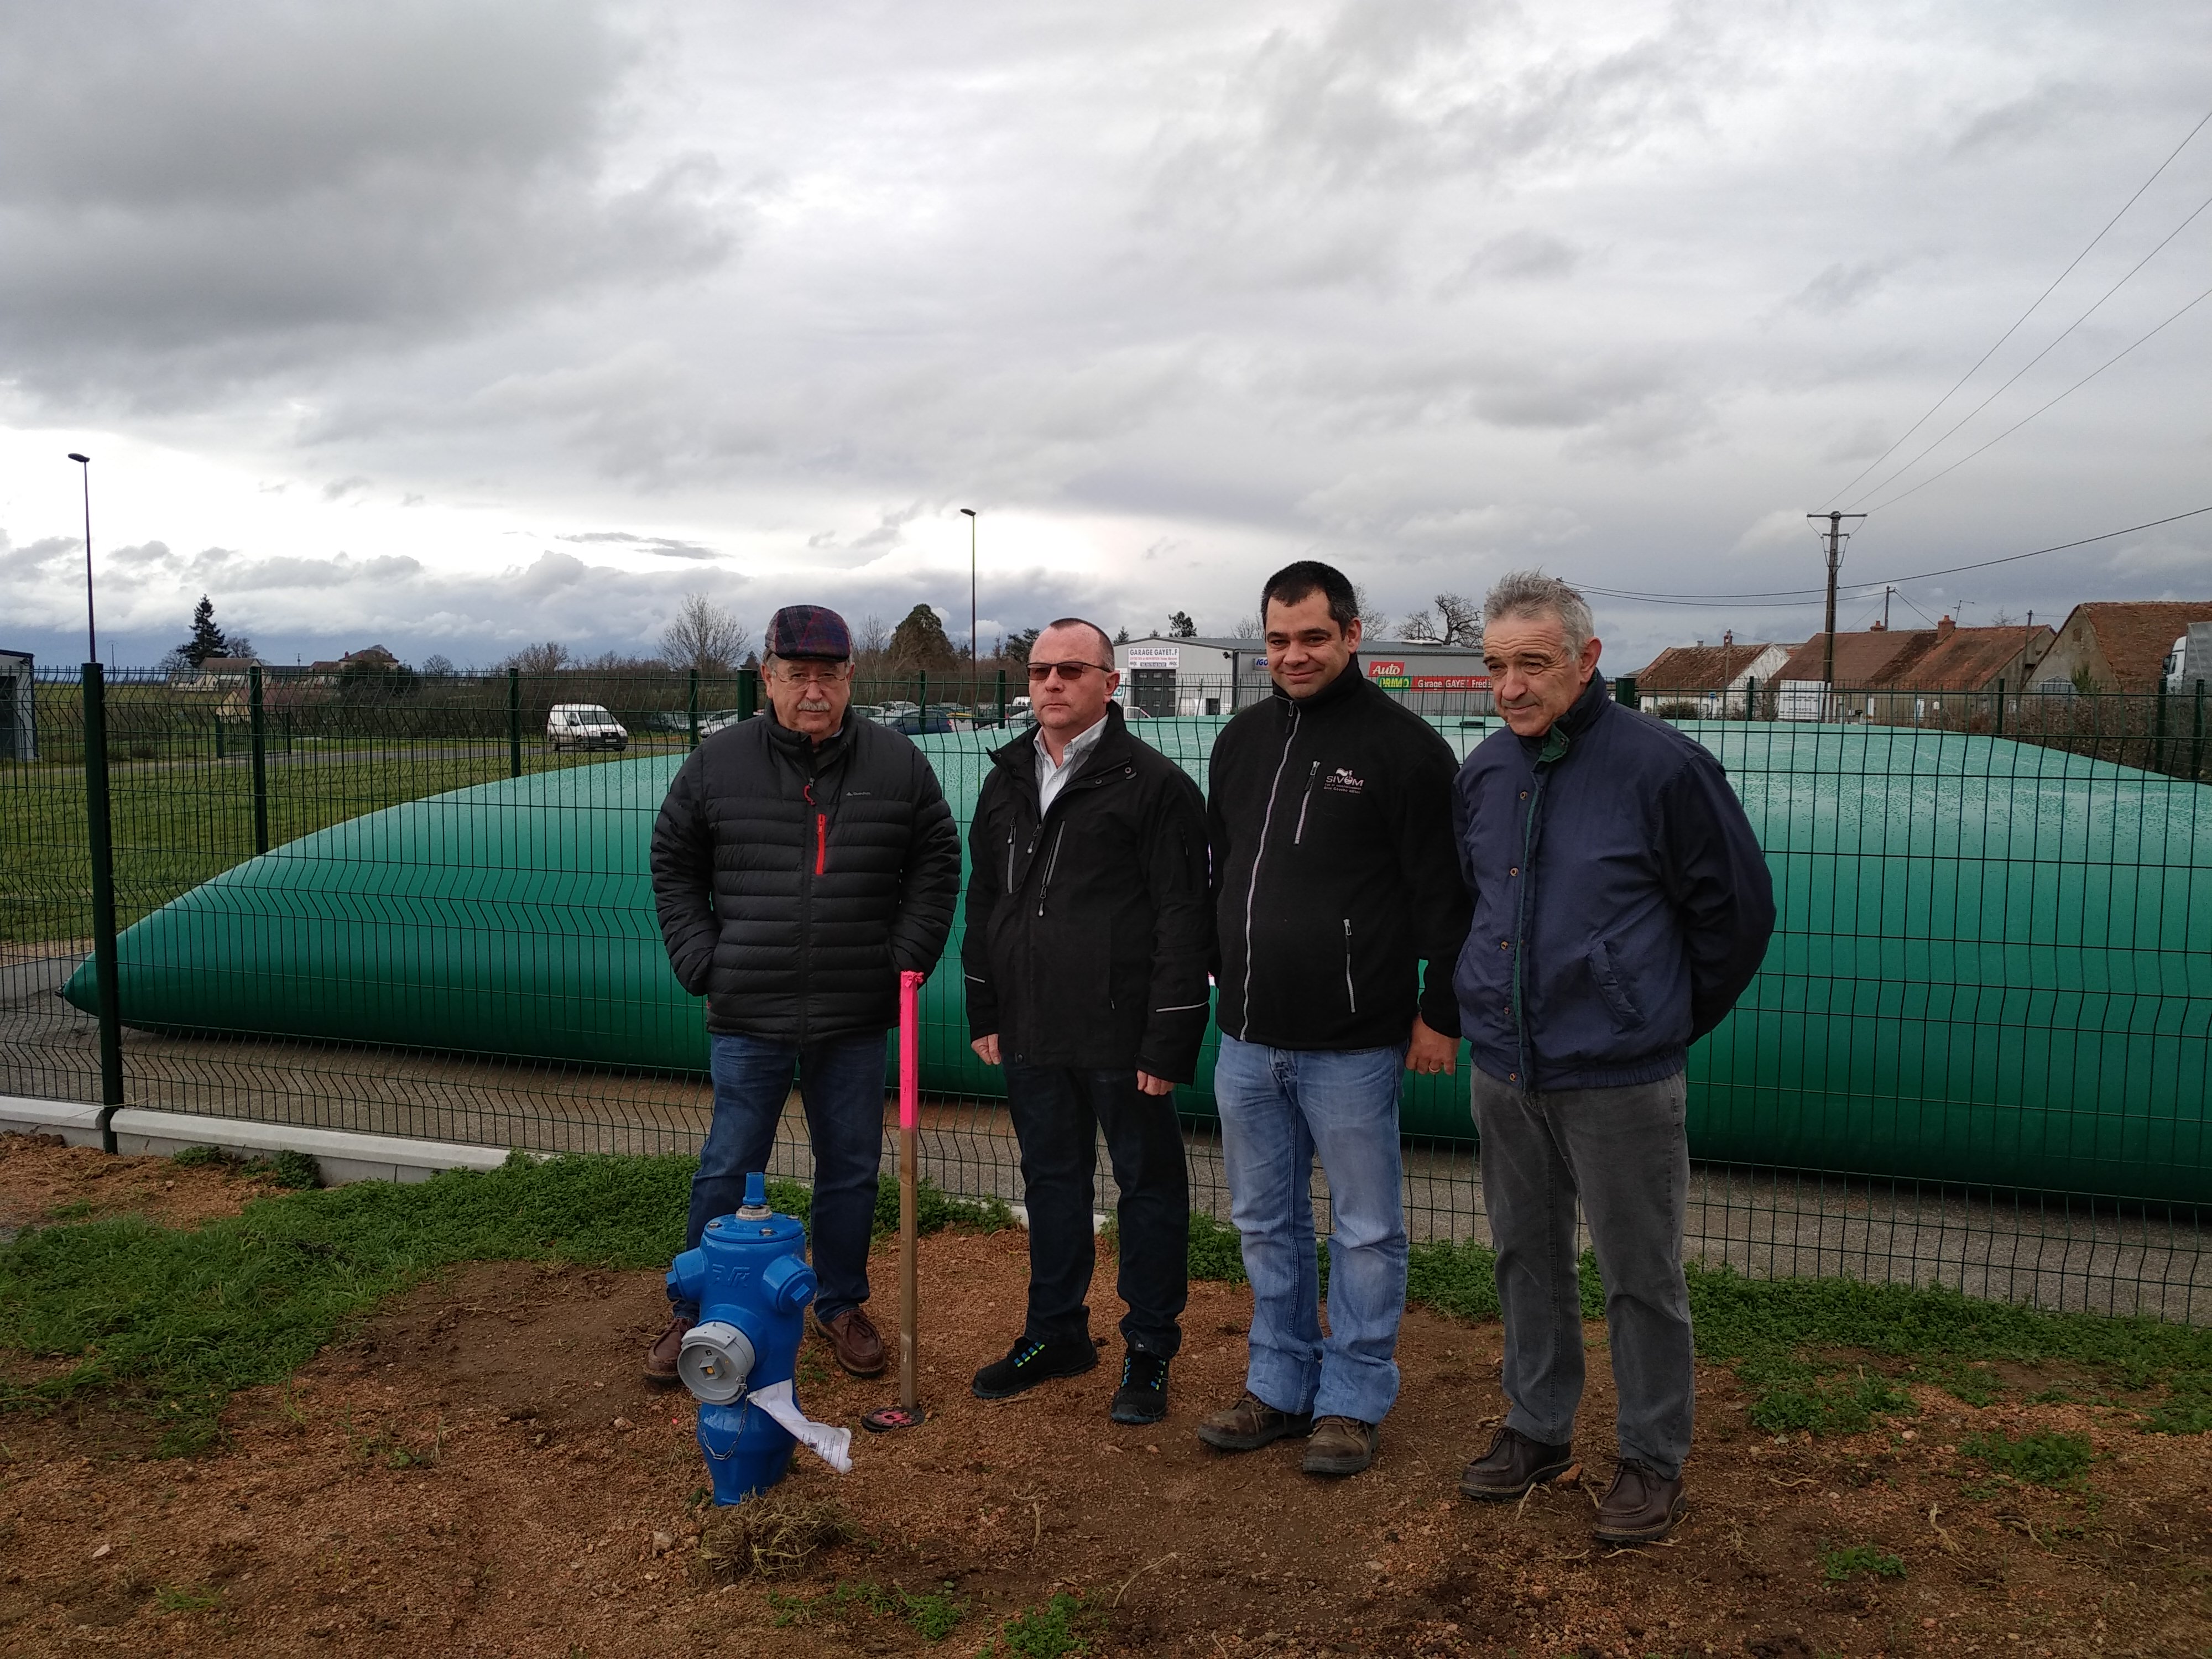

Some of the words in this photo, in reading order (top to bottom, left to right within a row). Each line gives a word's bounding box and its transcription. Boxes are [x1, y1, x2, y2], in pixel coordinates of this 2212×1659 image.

[1372, 664, 1401, 675] Auto
[1417, 679, 1442, 690] Garage
[1326, 775, 1364, 787] SIVOM
